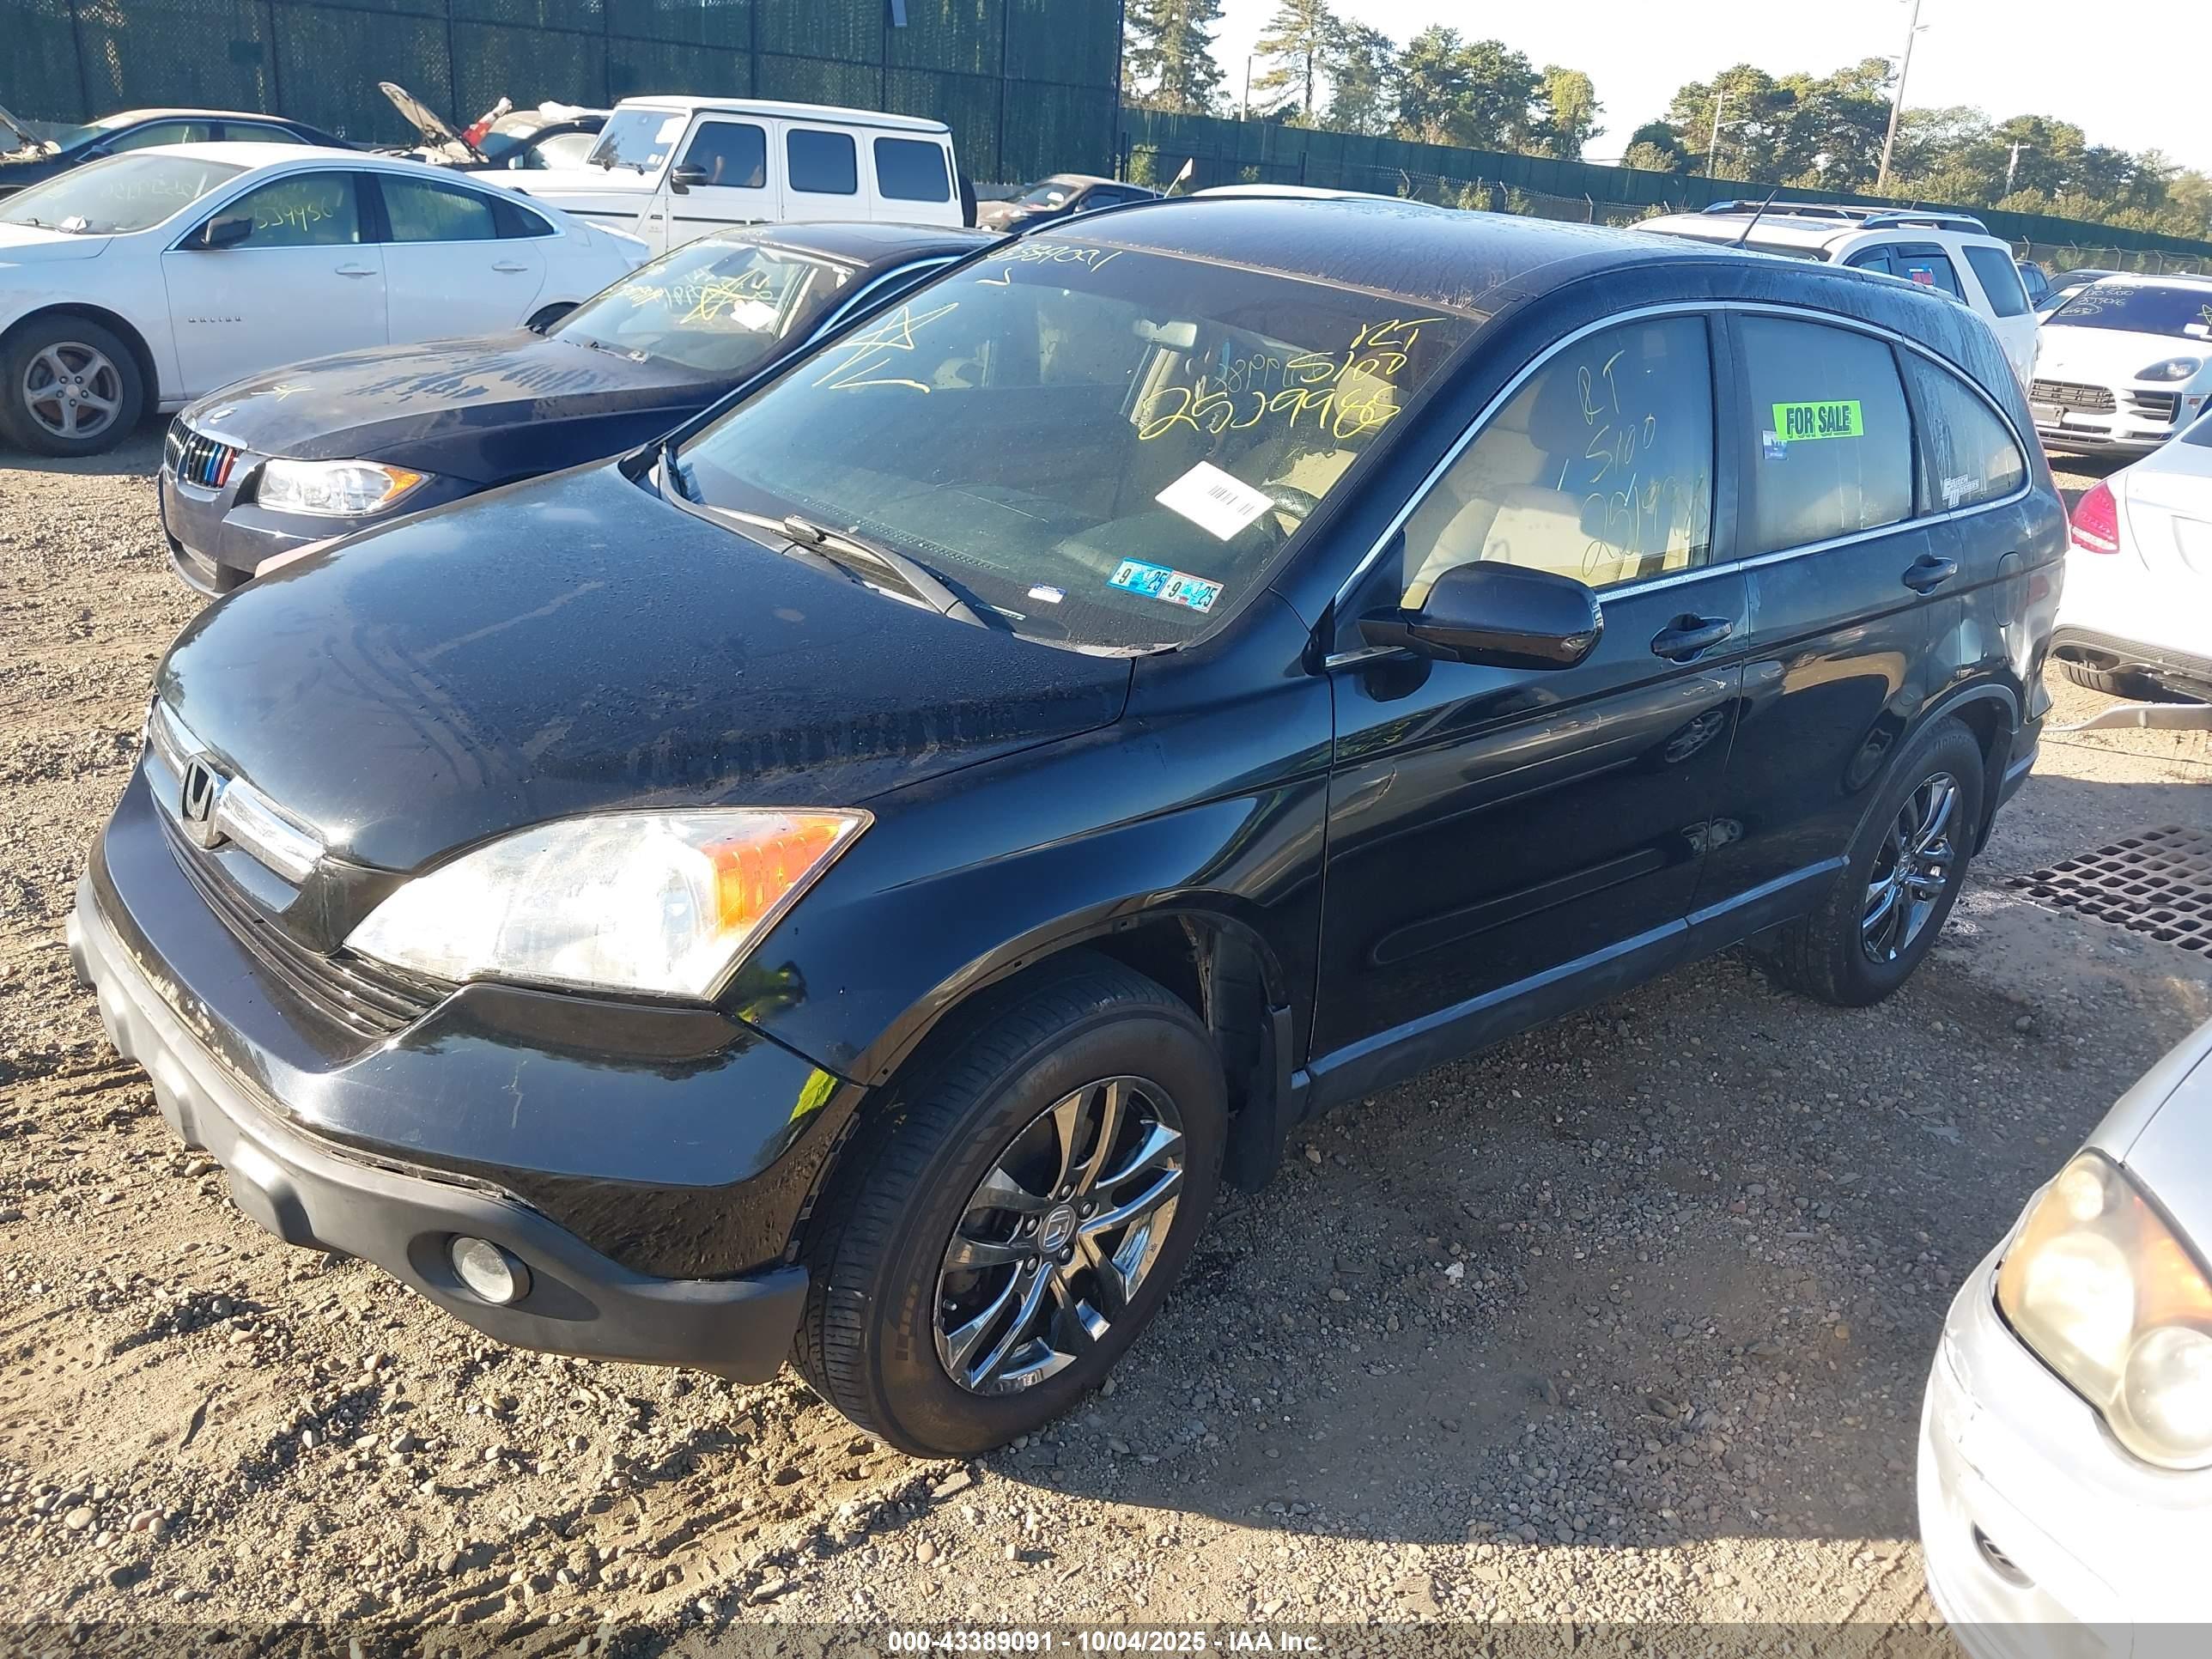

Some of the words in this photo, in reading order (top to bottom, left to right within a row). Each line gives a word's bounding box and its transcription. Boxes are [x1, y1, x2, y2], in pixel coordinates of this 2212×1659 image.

[1786, 406, 1816, 438] FOR
[1818, 405, 1851, 436] SALE
[1118, 568, 1132, 584] 9
[1147, 571, 1168, 592] 25
[1168, 580, 1182, 598] 9
[1196, 586, 1218, 607] 25
